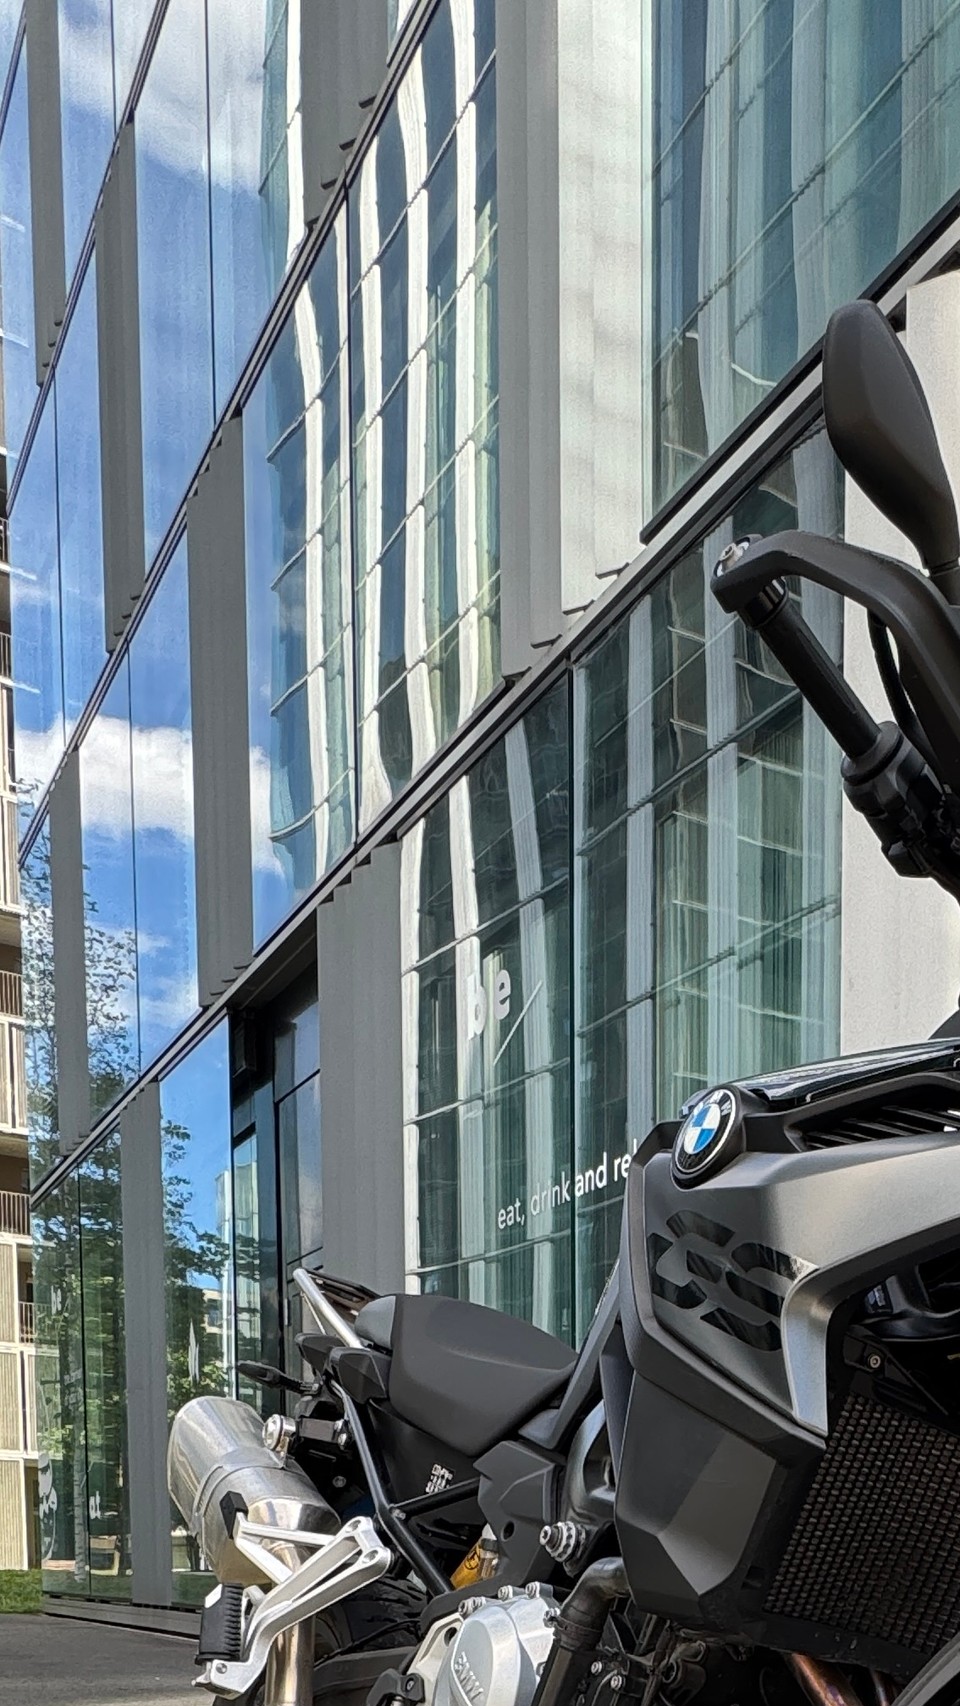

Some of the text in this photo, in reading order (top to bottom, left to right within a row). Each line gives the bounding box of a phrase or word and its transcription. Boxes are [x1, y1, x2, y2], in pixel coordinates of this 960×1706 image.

[466, 970, 511, 1041] be
[498, 1198, 525, 1230] eat,
[530, 1171, 571, 1217] drink
[574, 1151, 608, 1198] and
